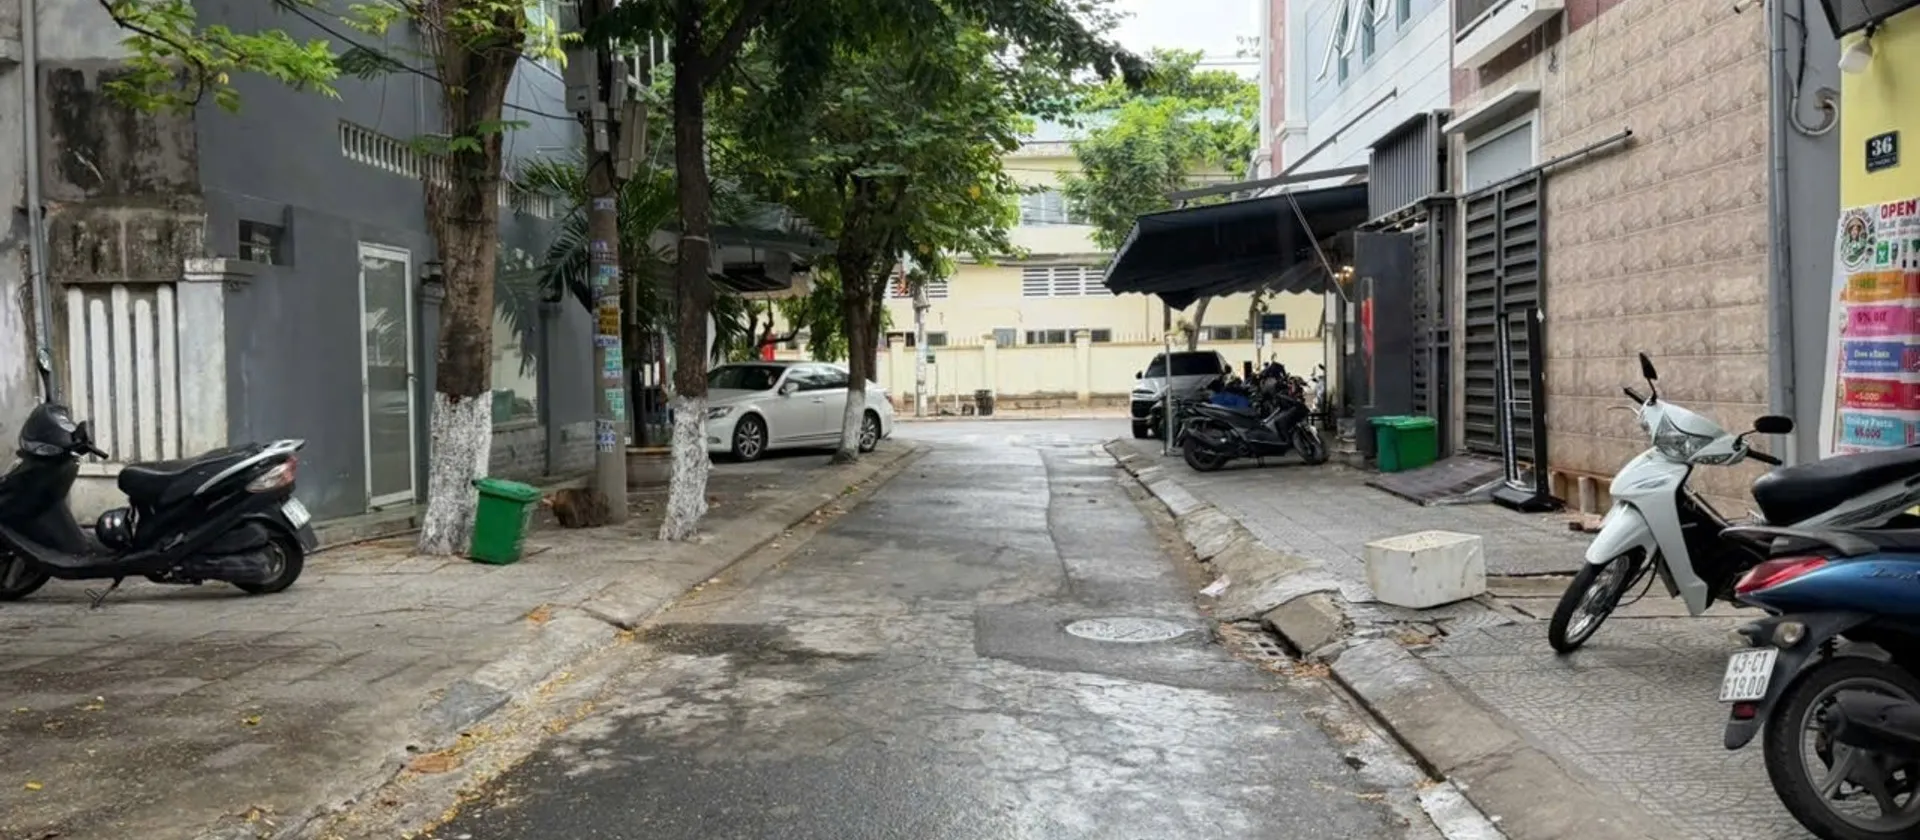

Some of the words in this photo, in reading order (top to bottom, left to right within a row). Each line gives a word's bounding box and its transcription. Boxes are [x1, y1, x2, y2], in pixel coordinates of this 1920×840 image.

[1871, 135, 1893, 156] 36
[1880, 199, 1916, 219] OPEN
[1734, 652, 1768, 673] 43-C1
